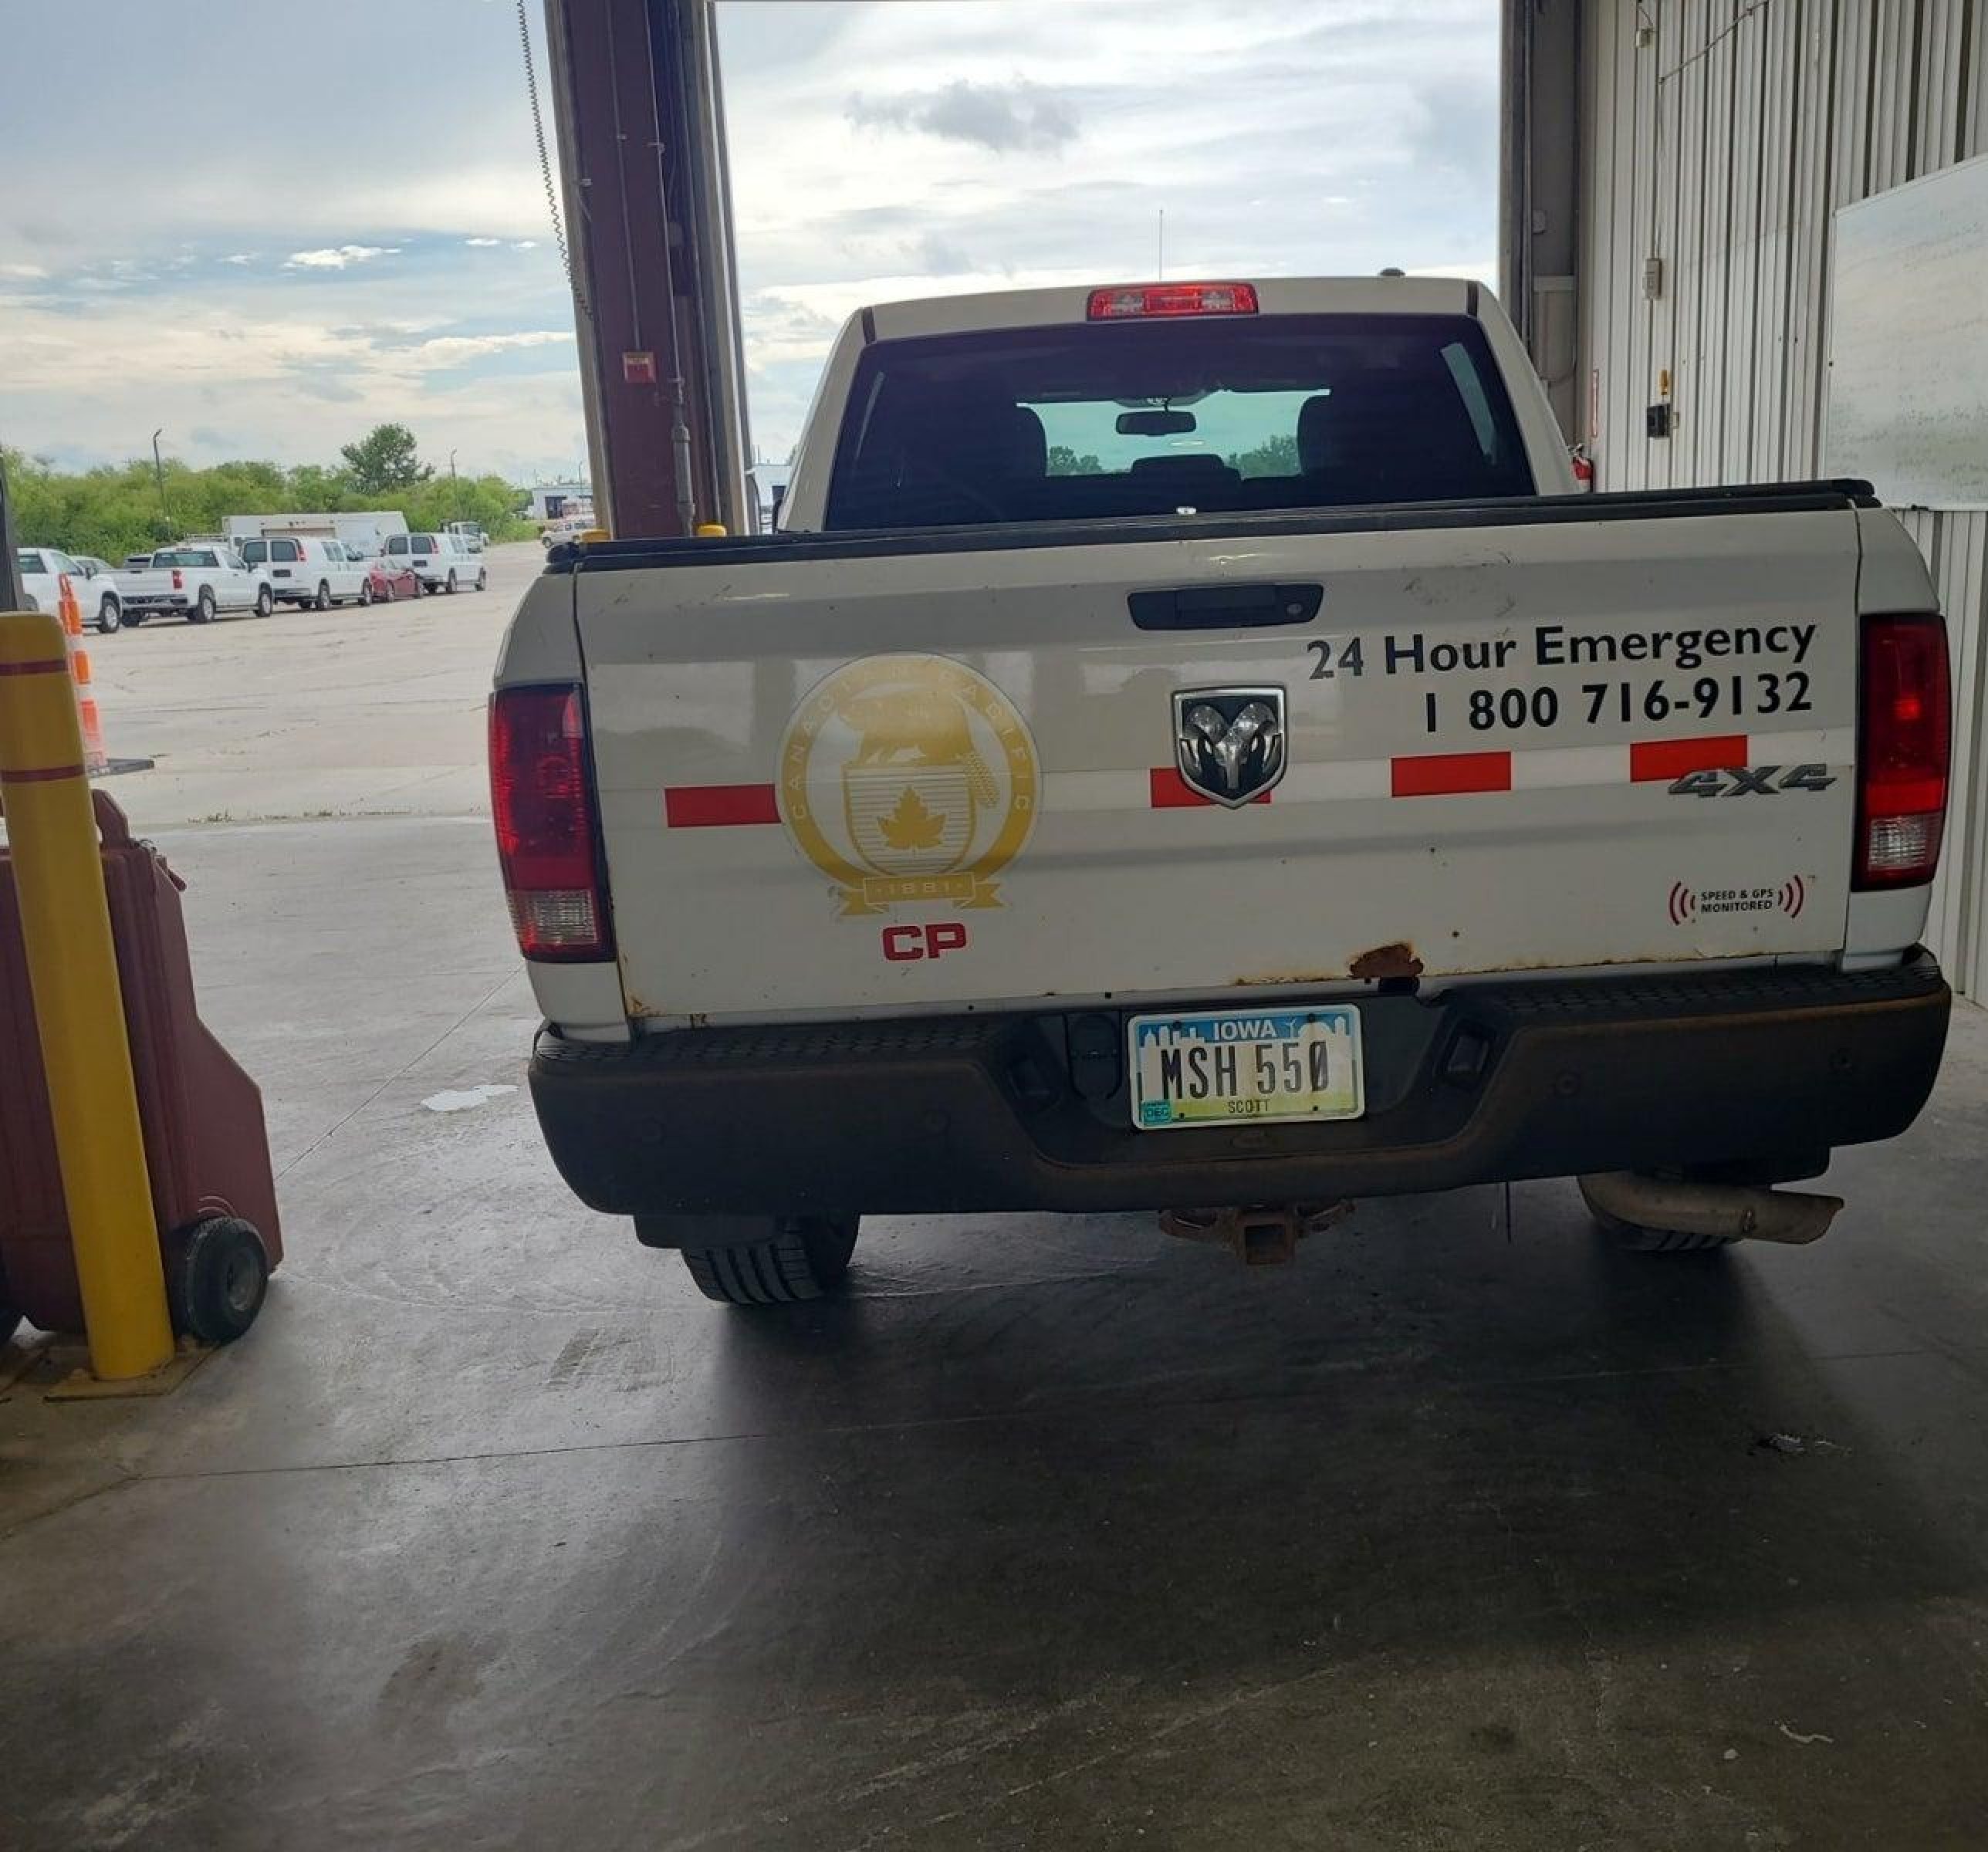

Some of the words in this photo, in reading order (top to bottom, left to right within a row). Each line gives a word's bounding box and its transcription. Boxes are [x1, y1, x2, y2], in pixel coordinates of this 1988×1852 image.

[1307, 636, 1364, 680] 24
[1385, 633, 1516, 675] Hour
[1536, 624, 1817, 669] Emergency
[1425, 692, 1436, 732] 1
[1469, 687, 1557, 731] 800
[1581, 671, 1812, 724] 716-9132
[1668, 763, 1837, 798] 4X4
[1701, 891, 1736, 901] SPEED
[1740, 890, 1749, 899] &
[1752, 888, 1774, 899] GPS
[1701, 901, 1773, 913] MONITORED
[882, 922, 967, 961] CP
[1213, 1019, 1277, 1042] IOWA
[1160, 1046, 1238, 1100] MSH
[1255, 1041, 1329, 1095] 550
[1228, 1098, 1271, 1114] SCOTT
